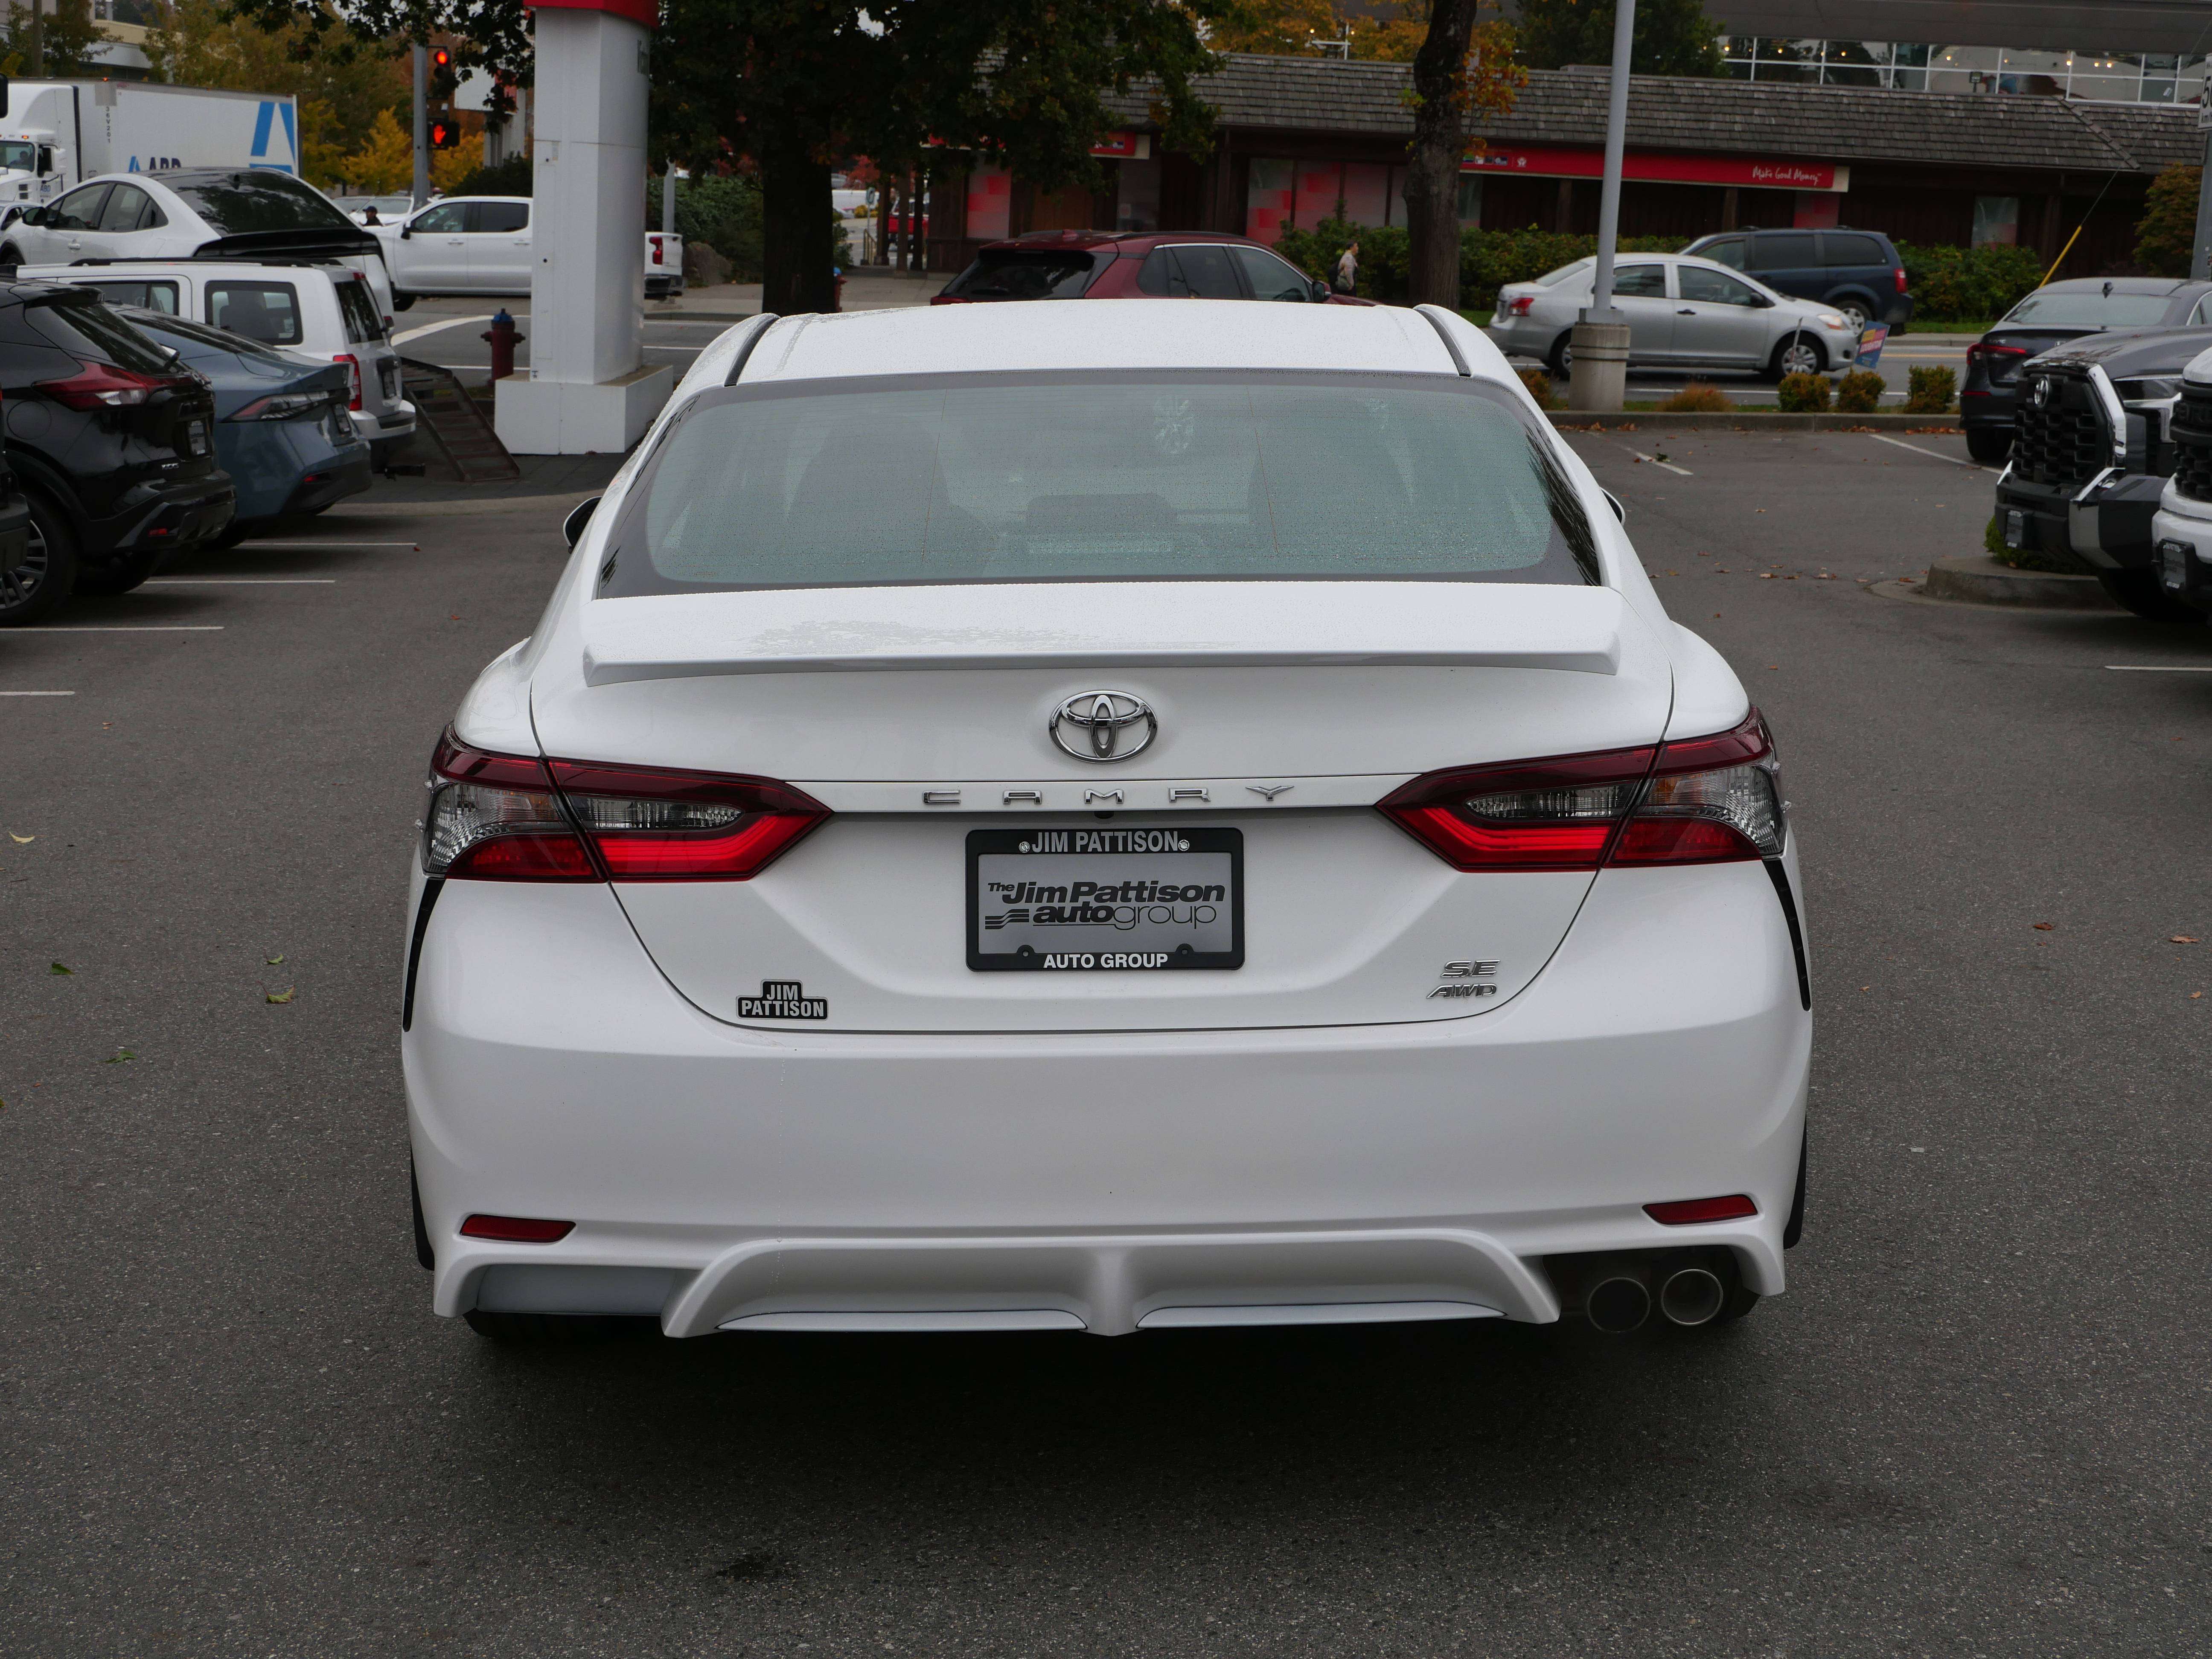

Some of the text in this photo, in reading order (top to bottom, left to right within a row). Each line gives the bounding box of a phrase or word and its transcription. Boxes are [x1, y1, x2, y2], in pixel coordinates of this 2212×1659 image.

[1752, 166, 1772, 180] Make
[1775, 167, 1792, 179] Good
[923, 786, 1295, 805] CAMRY
[1032, 830, 1179, 853] JIM PATTISON
[988, 880, 1225, 904] The Jim Pattison
[1043, 953, 1168, 969] AUTO GROUP
[1439, 959, 1501, 978] SE
[766, 984, 798, 1000] JIM
[1426, 983, 1497, 999] AWD
[741, 1000, 824, 1017] PATTISON
